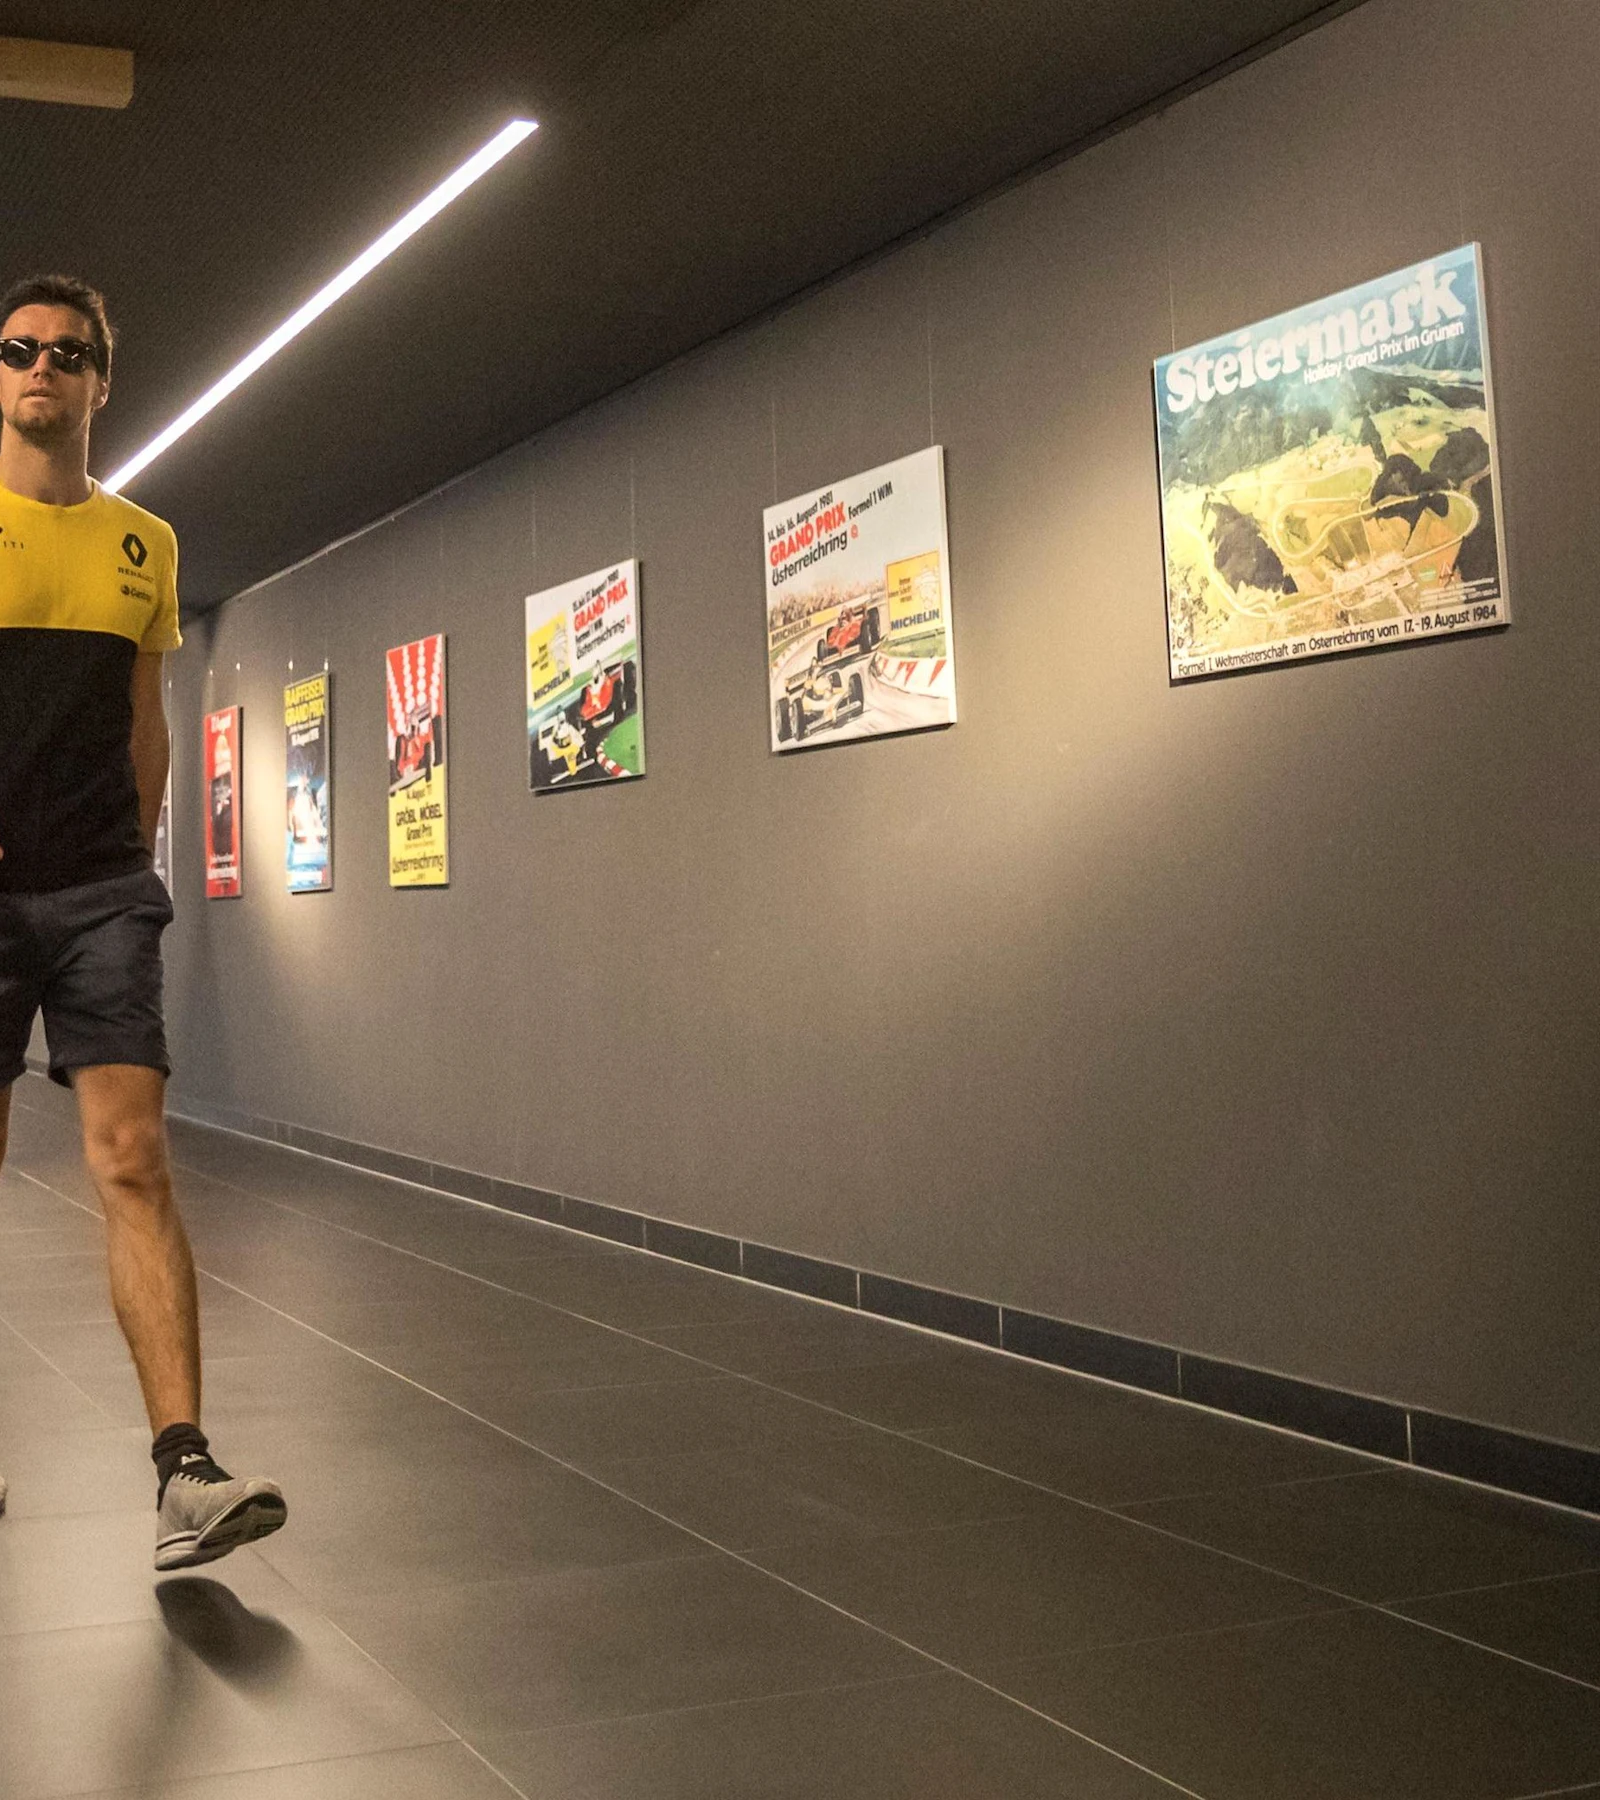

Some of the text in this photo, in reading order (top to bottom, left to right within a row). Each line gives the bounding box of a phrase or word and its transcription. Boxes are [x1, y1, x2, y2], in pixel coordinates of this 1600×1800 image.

[1166, 262, 1467, 413] Steiermark
[1303, 321, 1465, 385] Holiday Grand Prix im Grünen
[769, 522, 814, 567] GRAND
[815, 501, 846, 538] PRIX
[848, 492, 873, 520] Formel
[877, 481, 893, 501] WM
[796, 502, 818, 525] August
[574, 577, 628, 632] GRAND PRIX
[771, 618, 811, 647] MICHELIN
[890, 608, 940, 631] MICHELIN
[1178, 660, 1206, 676] Formel
[1215, 643, 1289, 669] Weltmeisterschaft
[1292, 641, 1307, 653] am
[1377, 624, 1400, 638] vom
[1434, 610, 1470, 628] August
[1473, 604, 1497, 622] 1984
